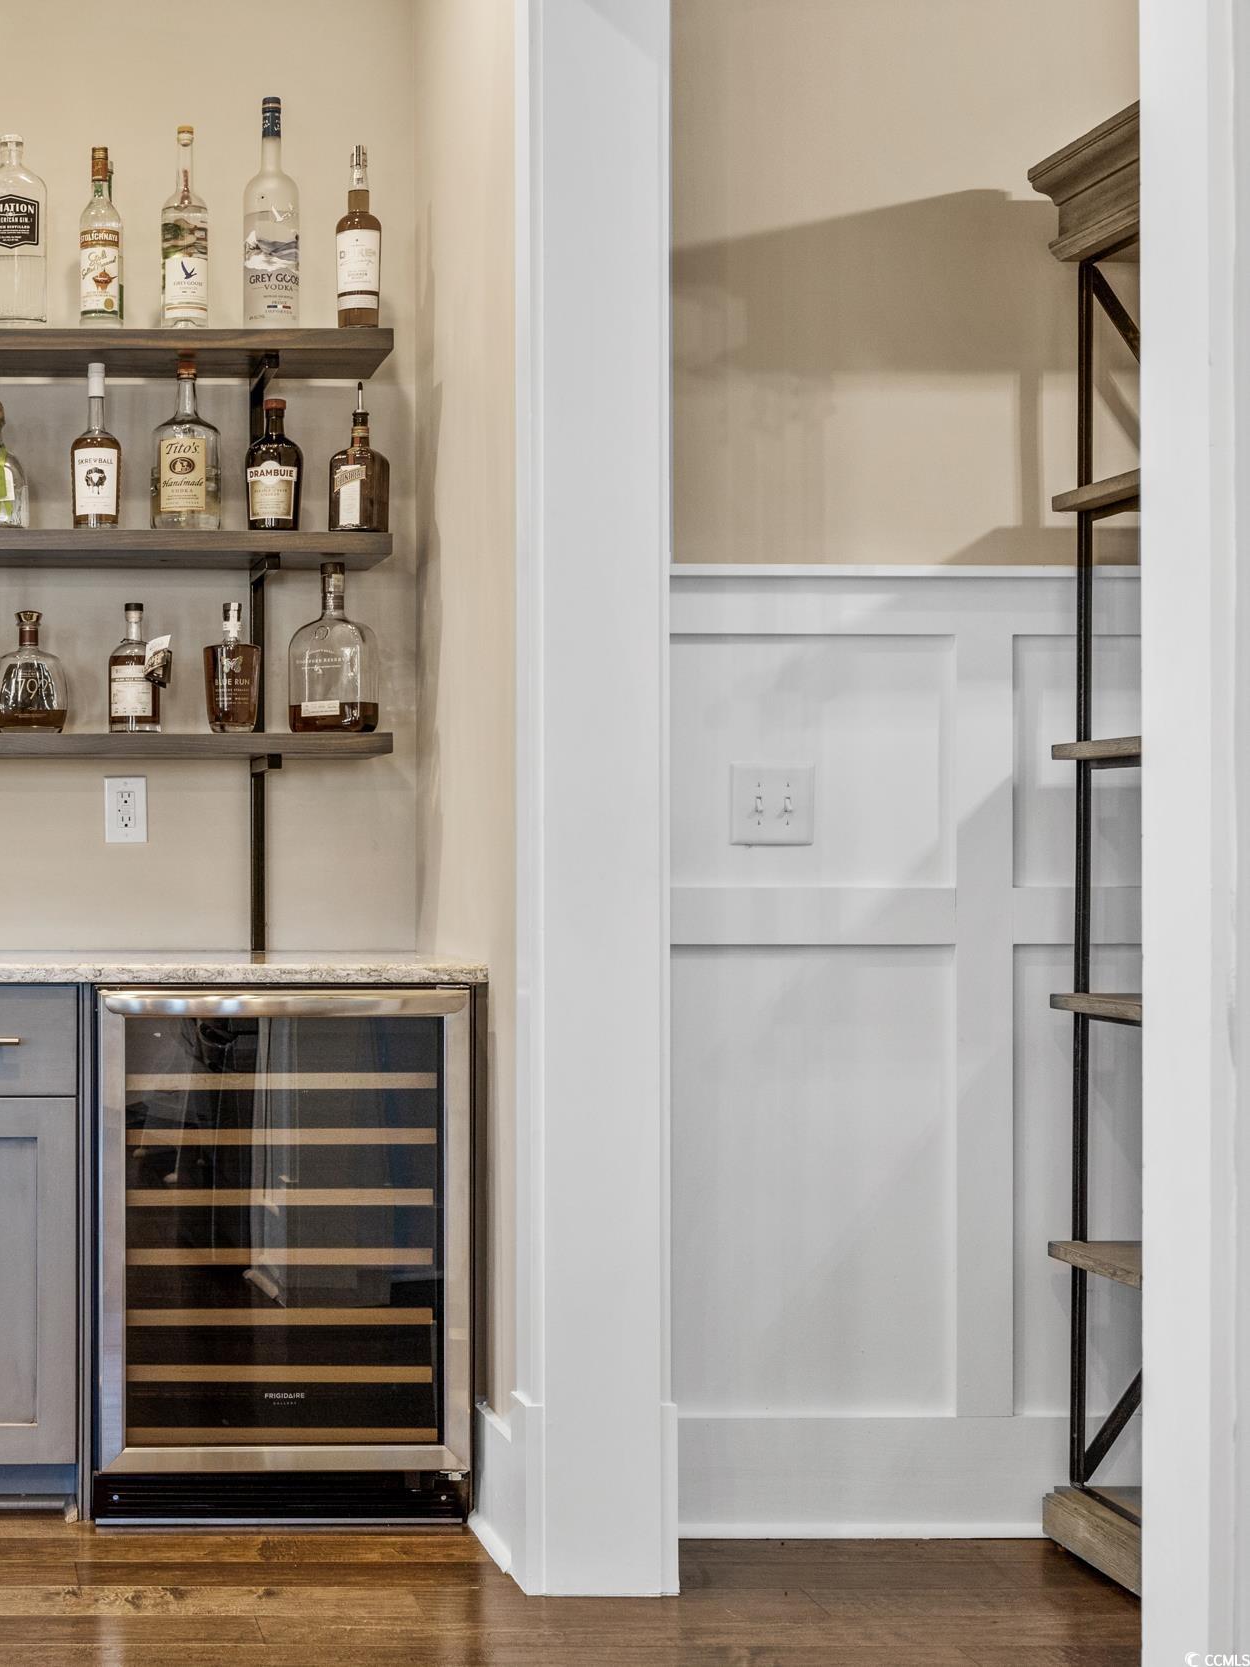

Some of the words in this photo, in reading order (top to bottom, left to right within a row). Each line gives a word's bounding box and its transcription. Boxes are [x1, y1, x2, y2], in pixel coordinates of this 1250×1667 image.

[249, 273, 273, 284] GREY
[275, 273, 299, 286] GOOS
[250, 469, 294, 478] DRAMBUIE
[162, 477, 204, 488] Handmade
[215, 678, 232, 686] BLUE
[234, 678, 250, 686] RUN
